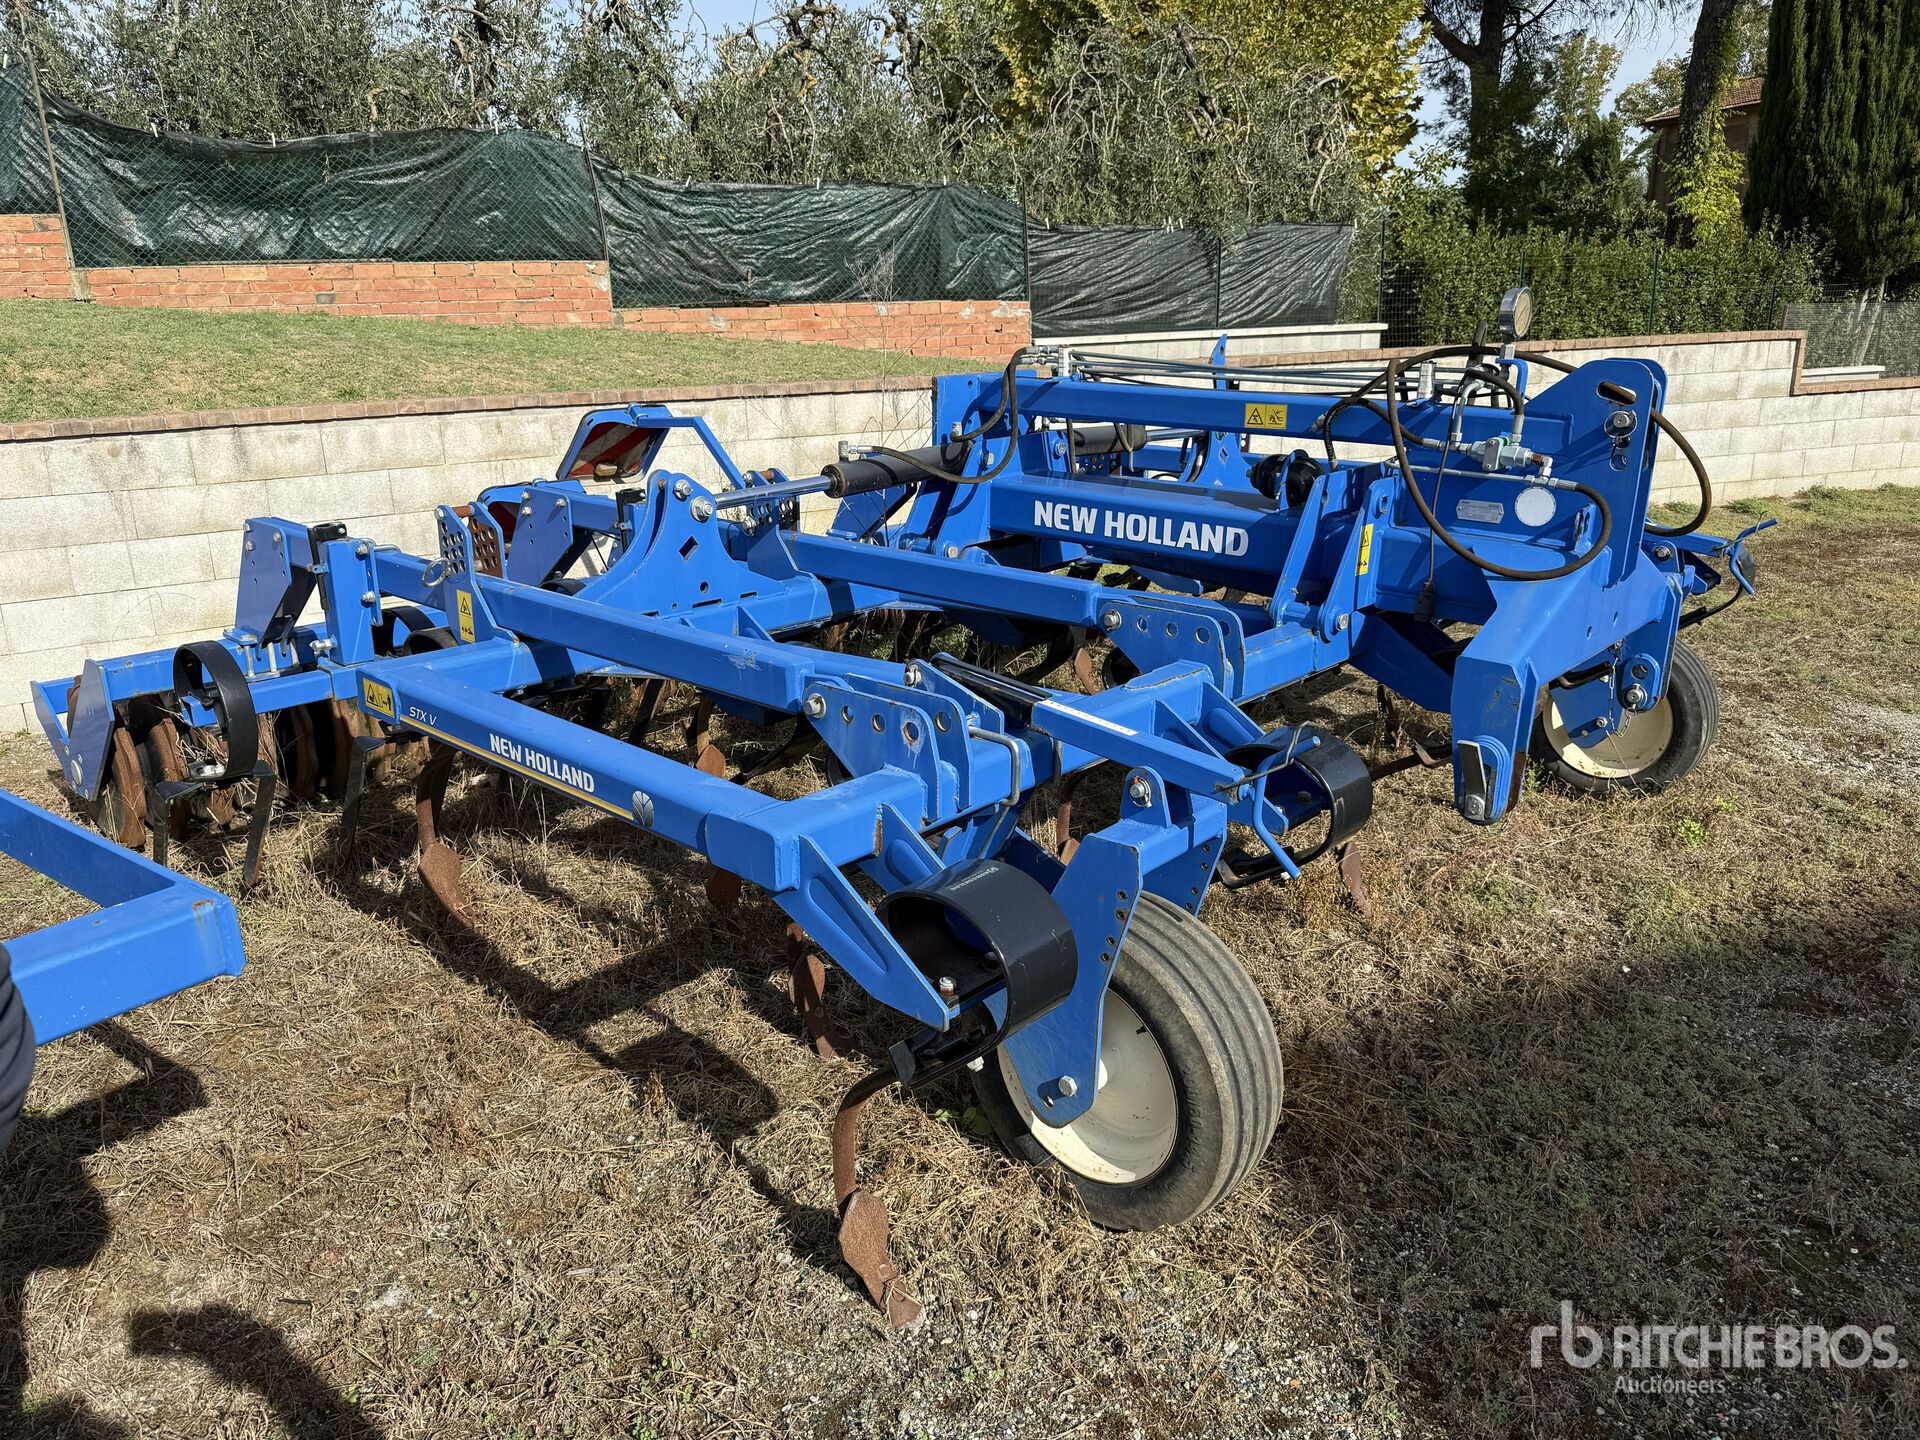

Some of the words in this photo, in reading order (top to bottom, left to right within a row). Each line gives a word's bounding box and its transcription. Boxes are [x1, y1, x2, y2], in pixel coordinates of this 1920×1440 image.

[1034, 500, 1098, 535] NEW
[1104, 510, 1249, 557] HOLLAND
[409, 706, 427, 722] STX
[429, 714, 437, 726] V
[489, 733, 522, 763] NEW
[524, 747, 595, 793] HOLLAND
